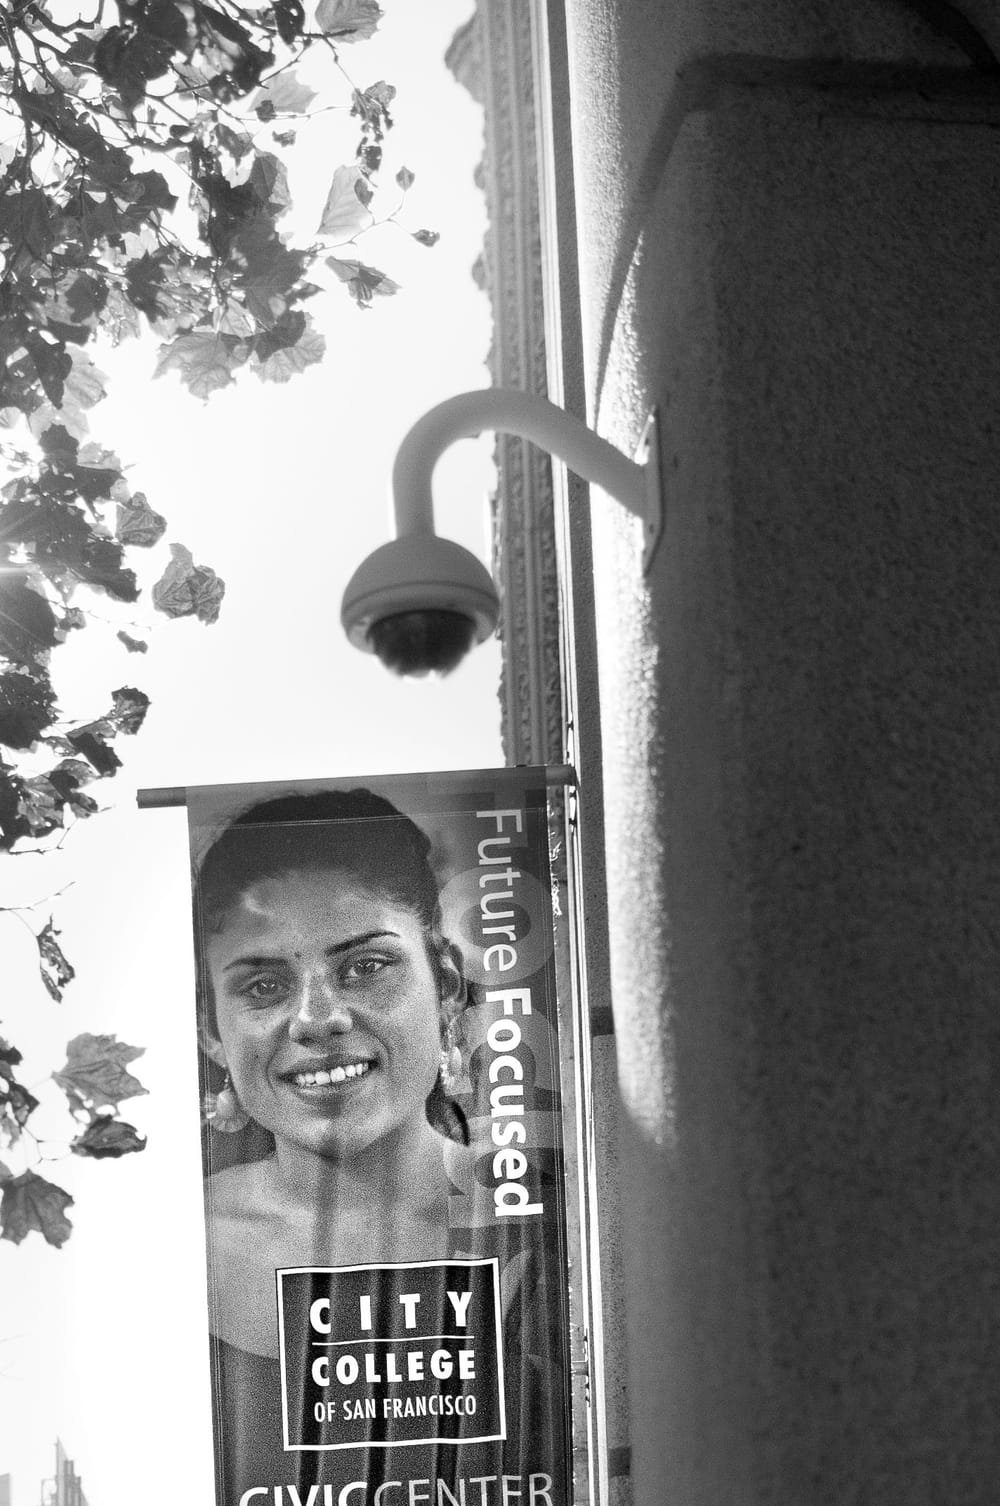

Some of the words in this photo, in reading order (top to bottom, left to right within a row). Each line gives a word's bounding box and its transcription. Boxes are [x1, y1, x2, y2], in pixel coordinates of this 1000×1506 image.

[476, 809, 522, 972] Future
[486, 987, 544, 1218] Focused
[309, 1291, 473, 1334] CITY
[311, 1350, 477, 1387] COLLEGE
[314, 1401, 336, 1423] OF
[343, 1398, 377, 1421] SAN
[383, 1394, 477, 1419] FRANCISCO
